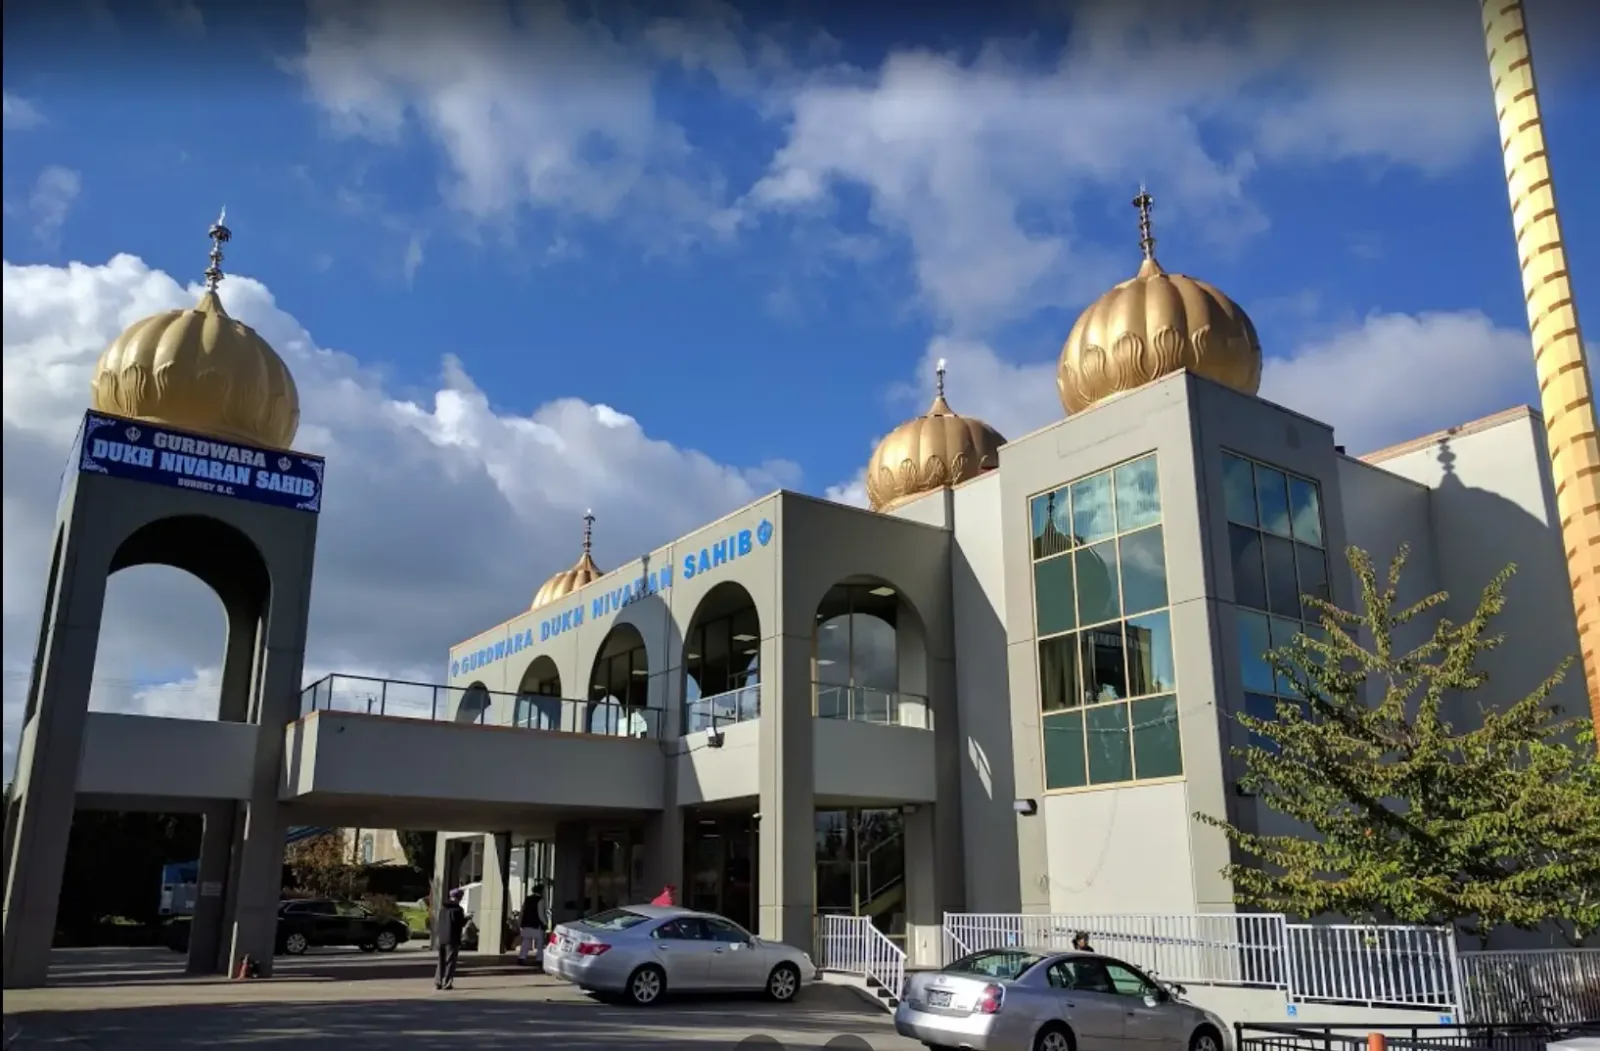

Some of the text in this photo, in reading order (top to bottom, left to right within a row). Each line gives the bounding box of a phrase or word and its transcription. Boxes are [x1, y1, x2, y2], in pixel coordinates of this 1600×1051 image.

[92, 438, 315, 498] DUKH NIVARAN SAHIB
[153, 432, 266, 468] GURDWARA
[460, 528, 753, 676] GURDWARA DUKH NIVARAN SAHIB
